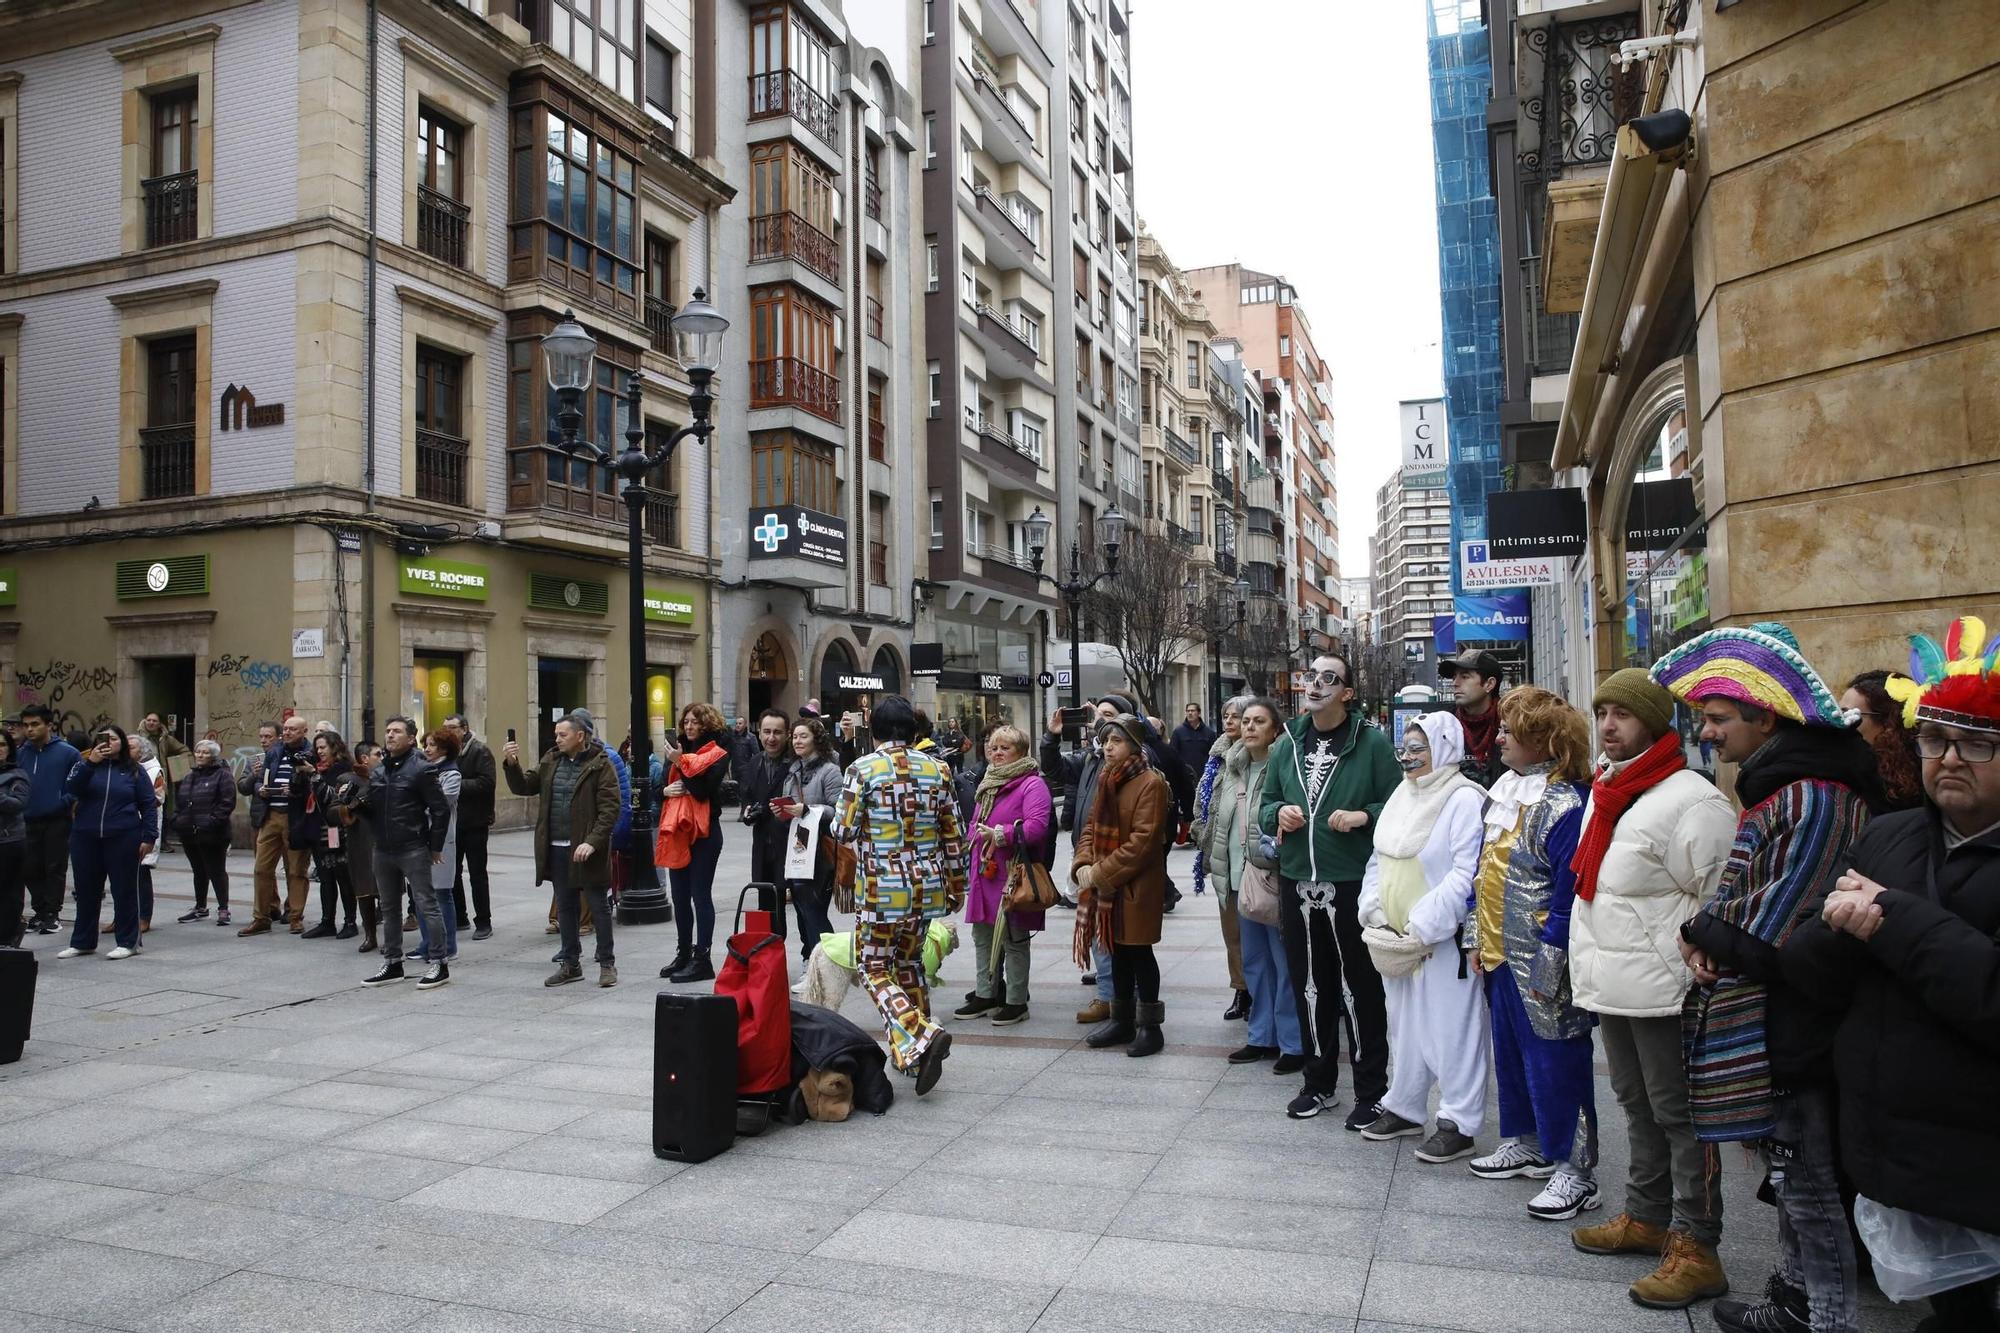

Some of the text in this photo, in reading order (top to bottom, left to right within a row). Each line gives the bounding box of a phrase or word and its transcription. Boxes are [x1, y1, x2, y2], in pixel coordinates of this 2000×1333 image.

[1404, 463, 1446, 471] ANDAMIOS
[406, 567, 485, 587] YVES ROCHER
[1466, 564, 1549, 579] AVILESINA
[430, 582, 461, 591] FRANCE
[663, 601, 692, 614] ROCHER
[839, 675, 884, 690] CALZEDONIA
[981, 674, 1002, 690] INSIDE
[1040, 675, 1051, 685] IN
